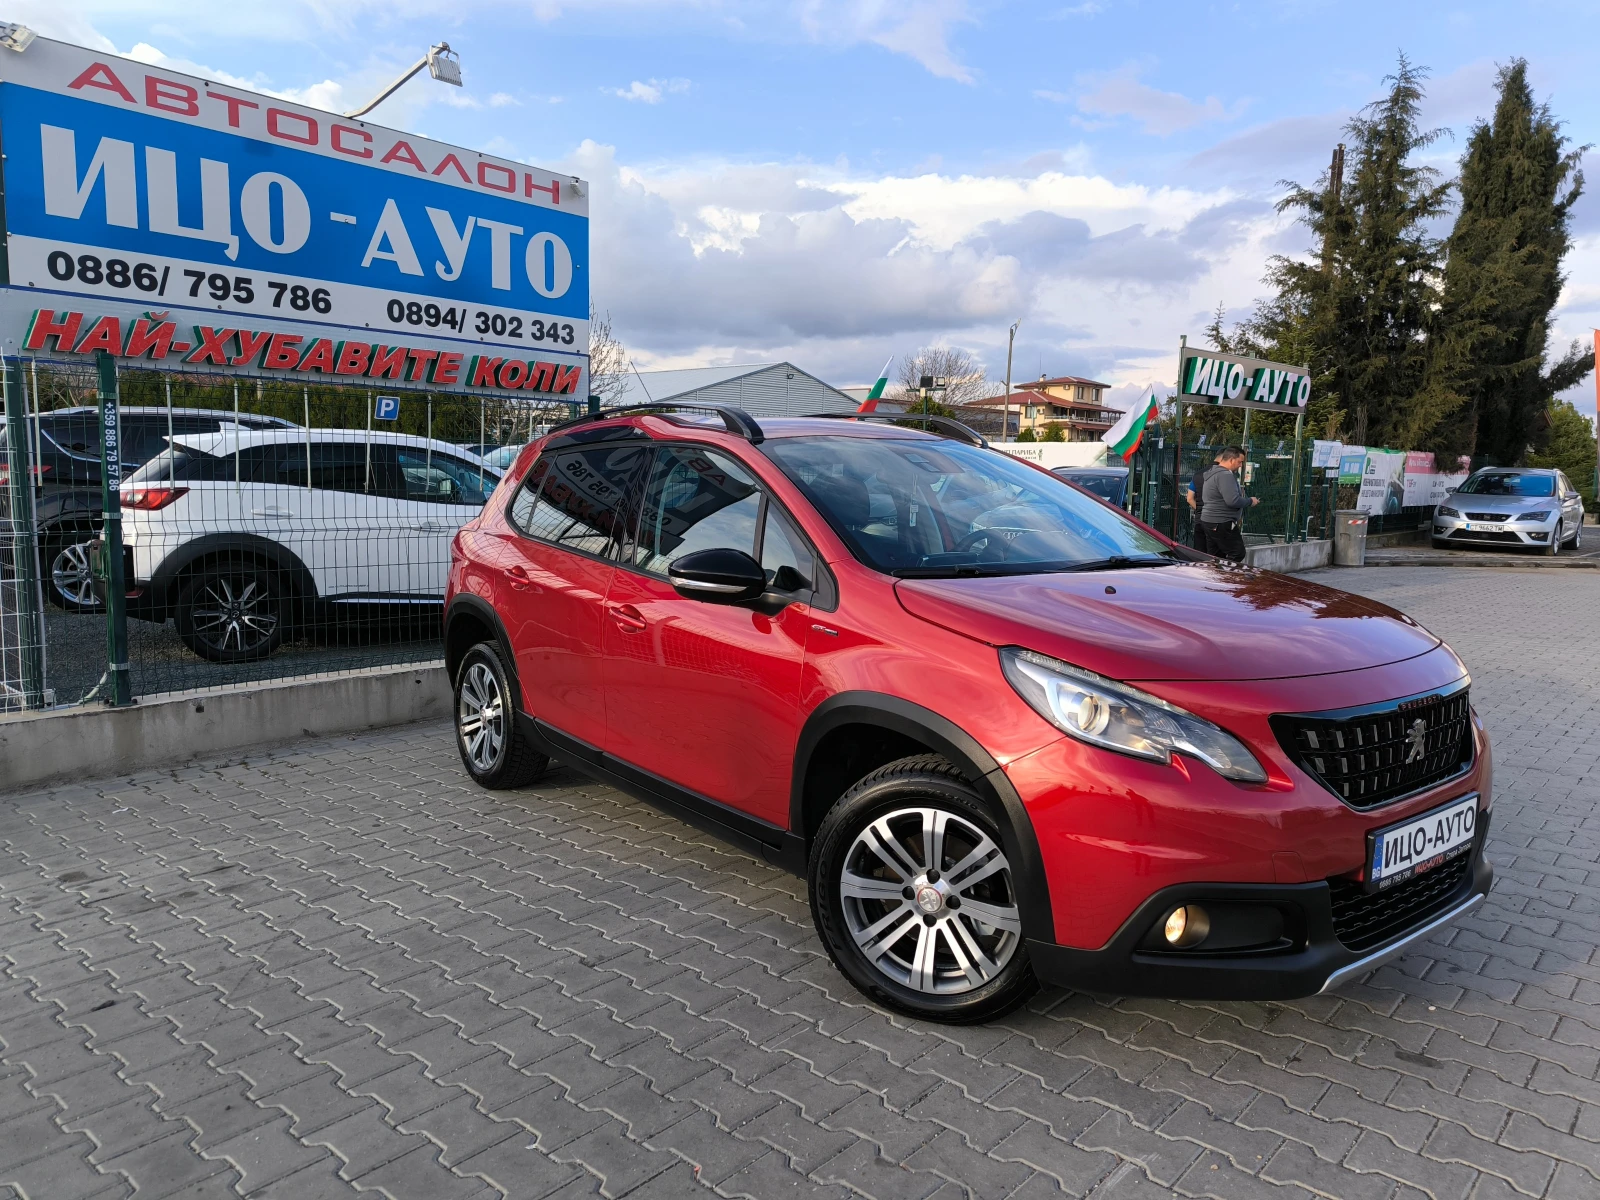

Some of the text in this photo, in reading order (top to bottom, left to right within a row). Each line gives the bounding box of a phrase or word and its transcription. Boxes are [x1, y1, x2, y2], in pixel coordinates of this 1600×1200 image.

[67, 61, 560, 205] АВТОСАЛОН
[47, 250, 332, 314] 0886/ 795 786
[23, 307, 583, 395] НАЙ-ХУБАВИТЕ КОЛИ
[387, 298, 575, 346] 0894/ 302 343
[380, 399, 395, 417] P
[1187, 356, 1311, 407] ИЦО-АУТО
[104, 401, 120, 492] +359 886 79 57 86
[1384, 805, 1475, 869] ИЦО-АУТО
[1371, 866, 1381, 880] BG
